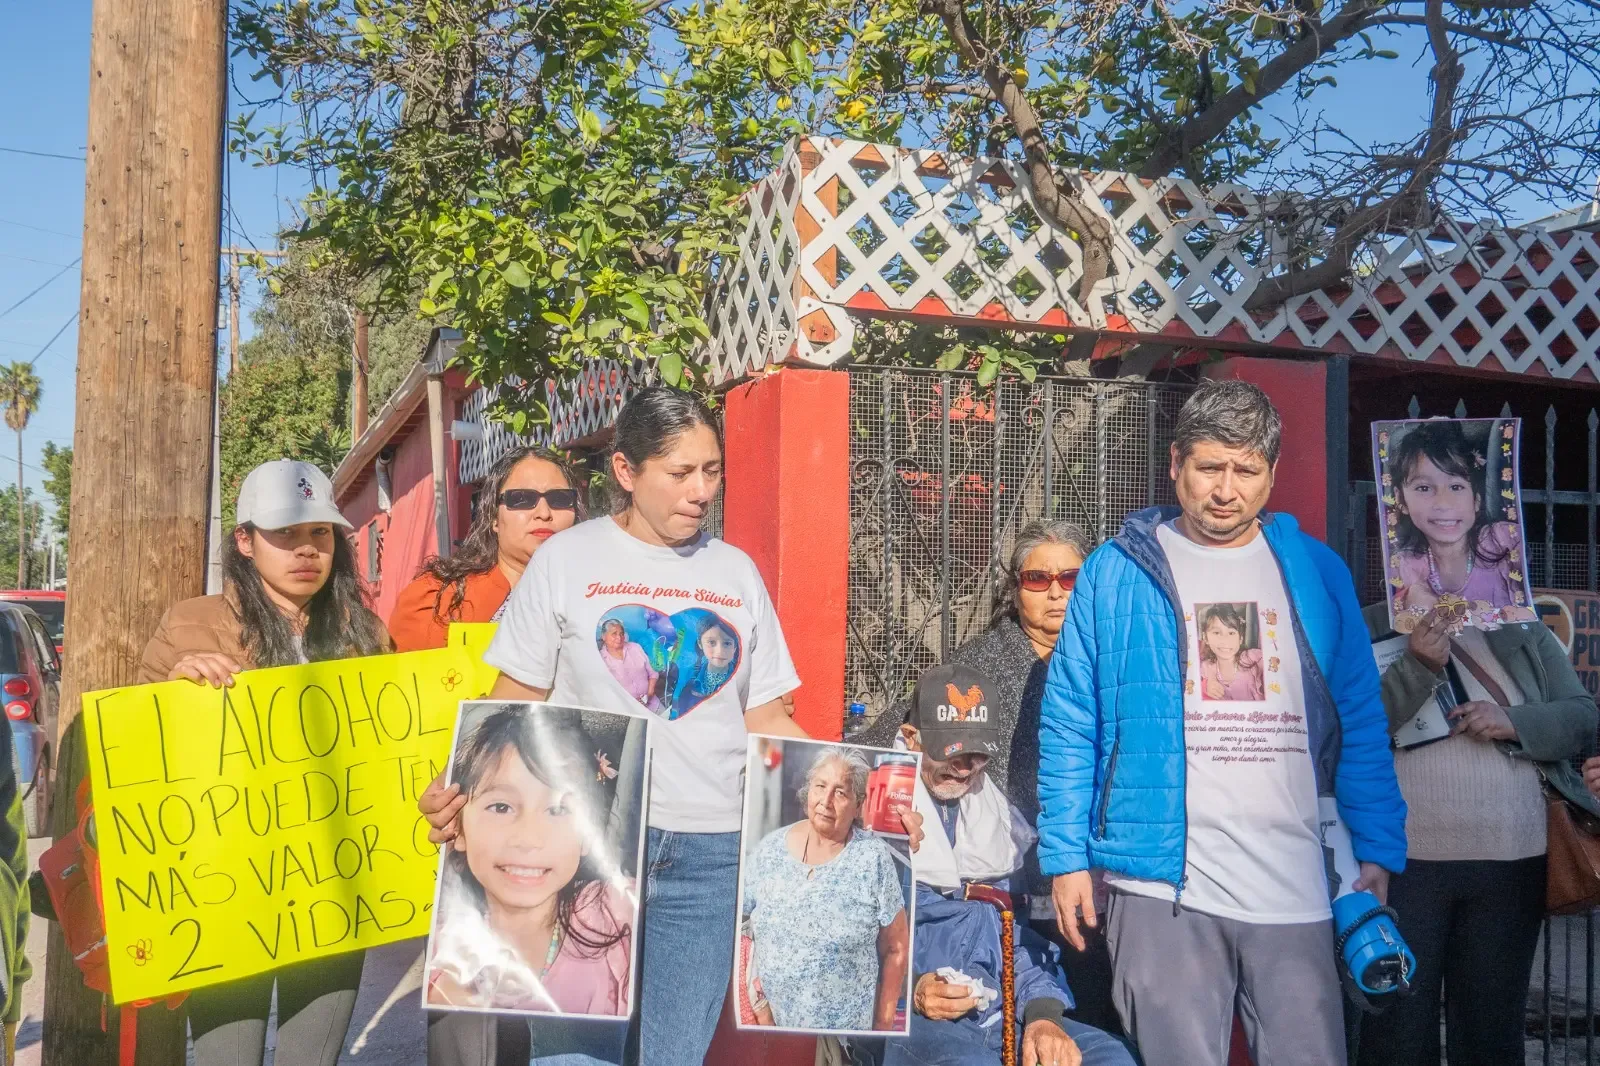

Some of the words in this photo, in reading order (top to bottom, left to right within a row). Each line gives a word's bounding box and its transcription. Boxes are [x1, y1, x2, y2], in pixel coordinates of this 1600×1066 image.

[585, 581, 651, 598] Justicia
[652, 587, 692, 600] para
[694, 588, 743, 608] Silvias
[1204, 710, 1246, 721] Aurora
[95, 691, 196, 789] EL
[1195, 746, 1211, 755] gran
[1237, 737, 1243, 745] y
[1212, 755, 1238, 764] siempre
[112, 794, 196, 855] NO
[200, 761, 374, 836] PUEDE
[115, 851, 237, 914] MÁS
[248, 824, 404, 896] VALOR
[168, 918, 224, 982] 2
